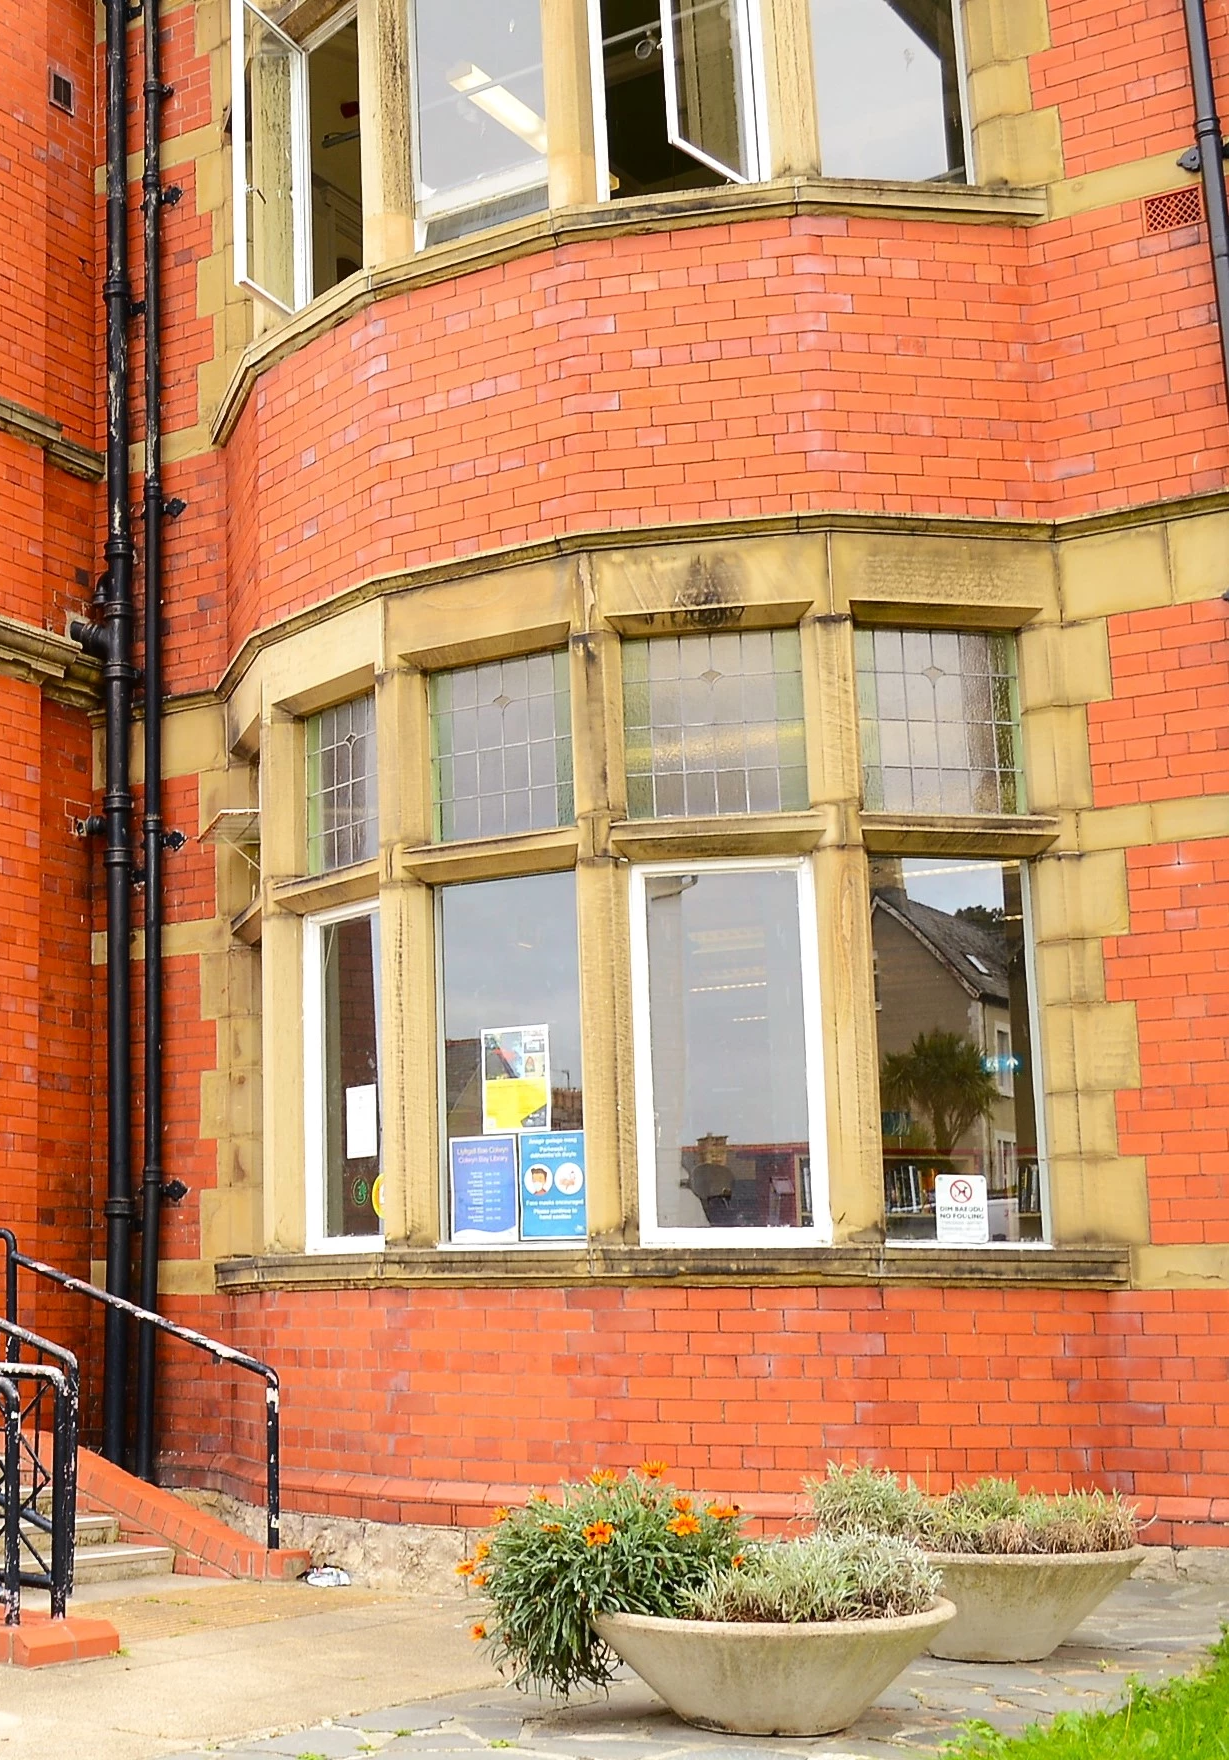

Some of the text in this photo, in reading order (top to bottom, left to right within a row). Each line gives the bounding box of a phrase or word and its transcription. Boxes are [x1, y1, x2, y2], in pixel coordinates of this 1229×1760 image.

[489, 1146, 509, 1155] Colwyn
[458, 1156, 478, 1165] Colwyn
[490, 1155, 508, 1163] Library
